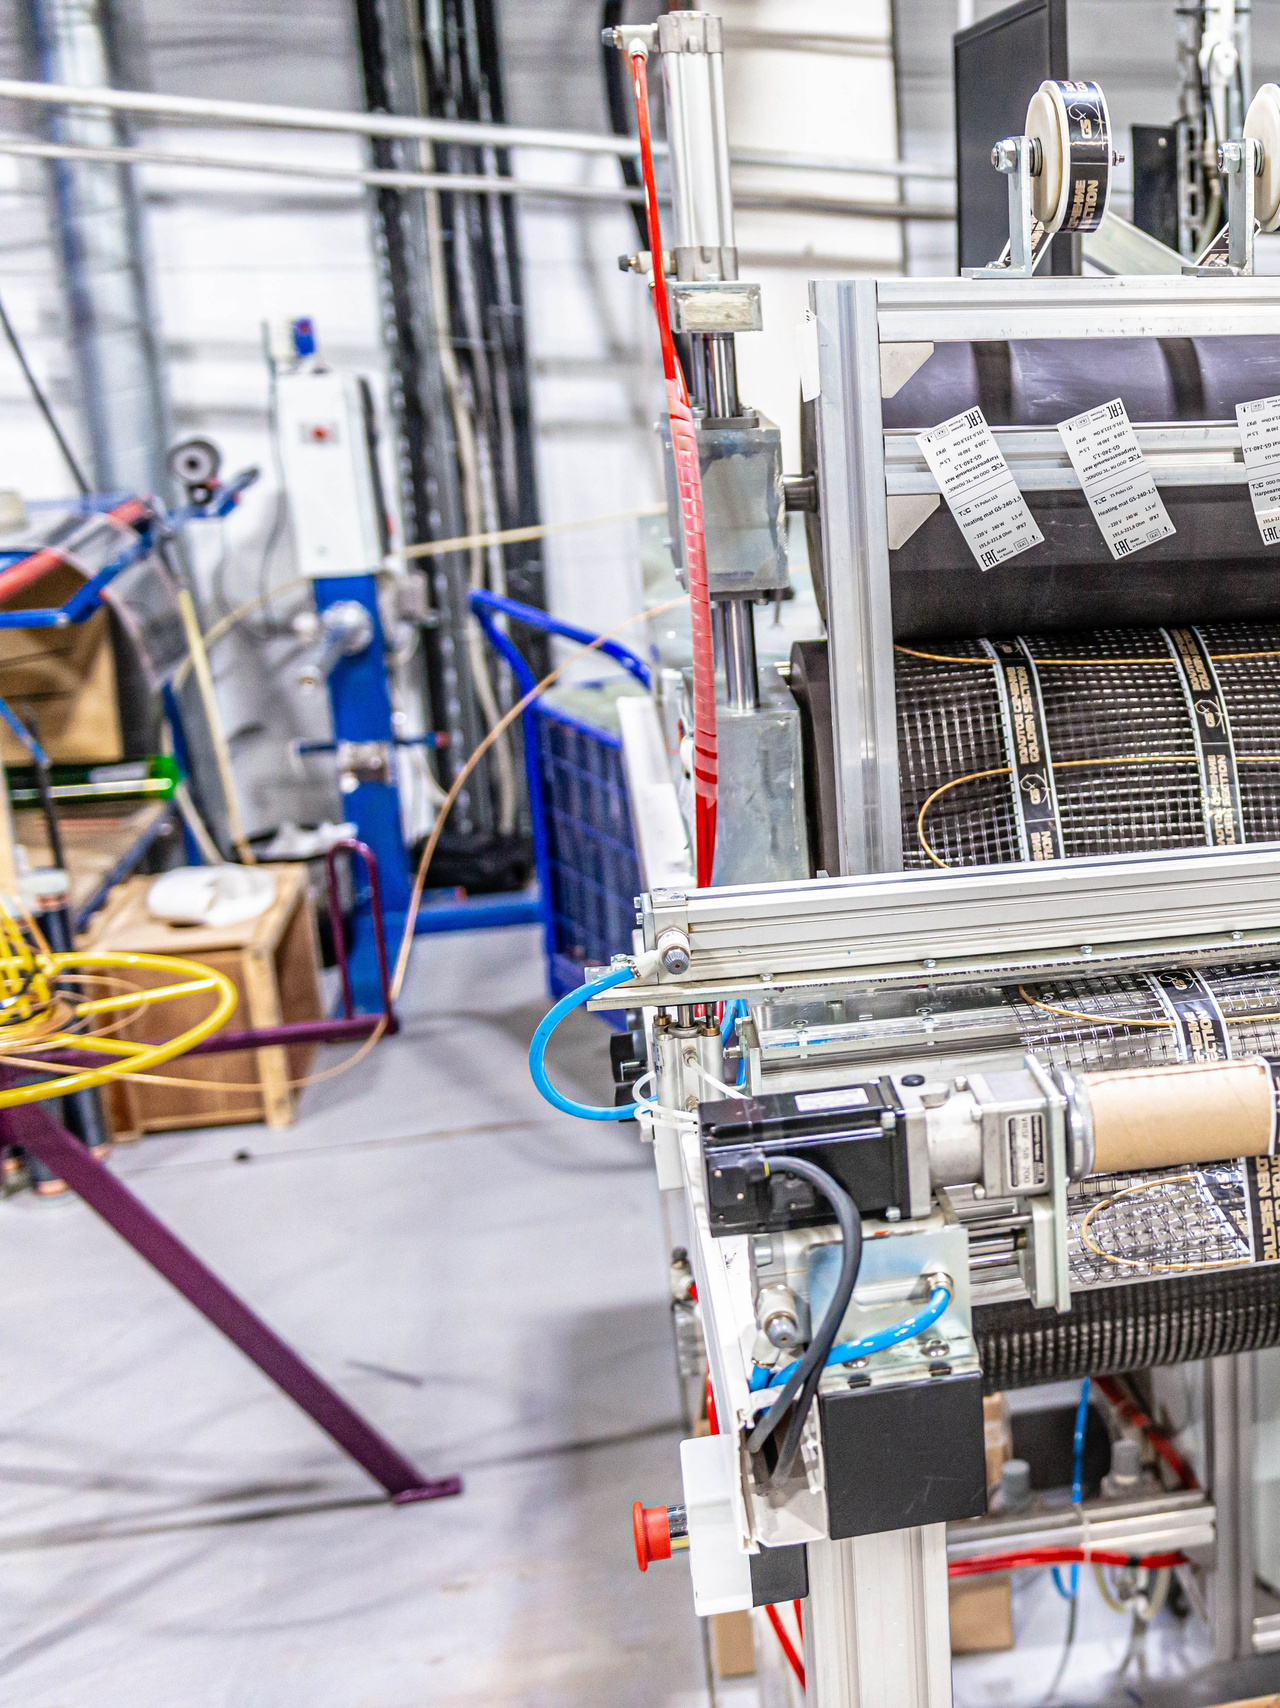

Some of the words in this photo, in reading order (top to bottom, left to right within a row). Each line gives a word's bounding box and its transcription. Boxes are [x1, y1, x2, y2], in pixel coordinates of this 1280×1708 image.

[954, 454, 981, 470] GS-240-1,5
[1092, 444, 1120, 459] GS-240-1,5
[1093, 446, 1136, 468] Нагревательный
[1244, 443, 1271, 453] GS-240-1,5
[955, 455, 998, 478] Нагревательный
[963, 516, 983, 528] Heating
[994, 496, 1021, 512] GS-240-1,5
[1098, 505, 1118, 516] Heating
[1128, 487, 1155, 502] GS-240-1,5
[1192, 655, 1212, 690] GOLDEN
[1016, 666, 1034, 713] SECTION
[1014, 713, 1029, 763] ЗОЛОТОЕ
[1024, 714, 1040, 763] GOLDEN
[1217, 754, 1232, 807] SECTION
[1195, 1010, 1219, 1063] ECTION
[1259, 1199, 1277, 1260] SECTIO
